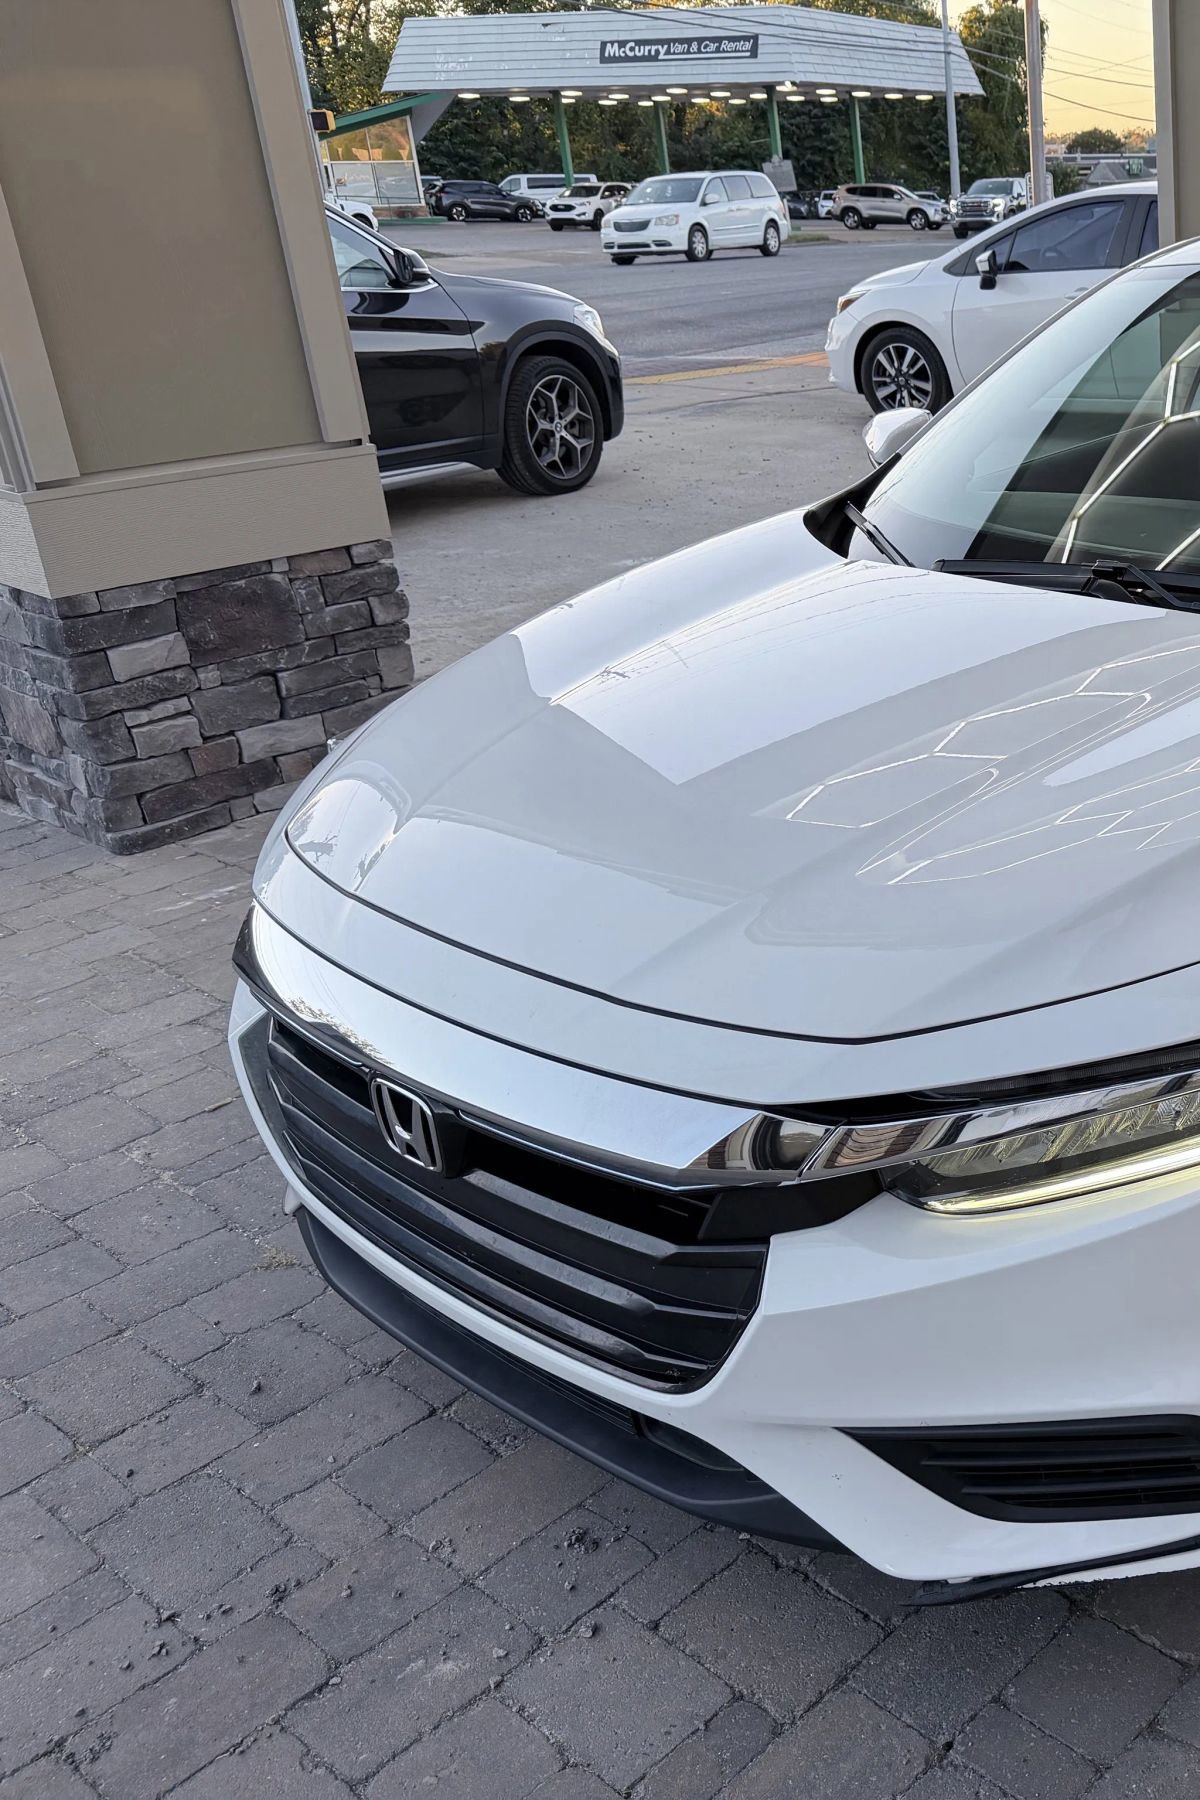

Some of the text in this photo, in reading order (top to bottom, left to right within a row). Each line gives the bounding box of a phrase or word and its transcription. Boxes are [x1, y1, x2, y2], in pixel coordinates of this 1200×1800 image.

[604, 39, 754, 60] McCurry Van & Car Rental
